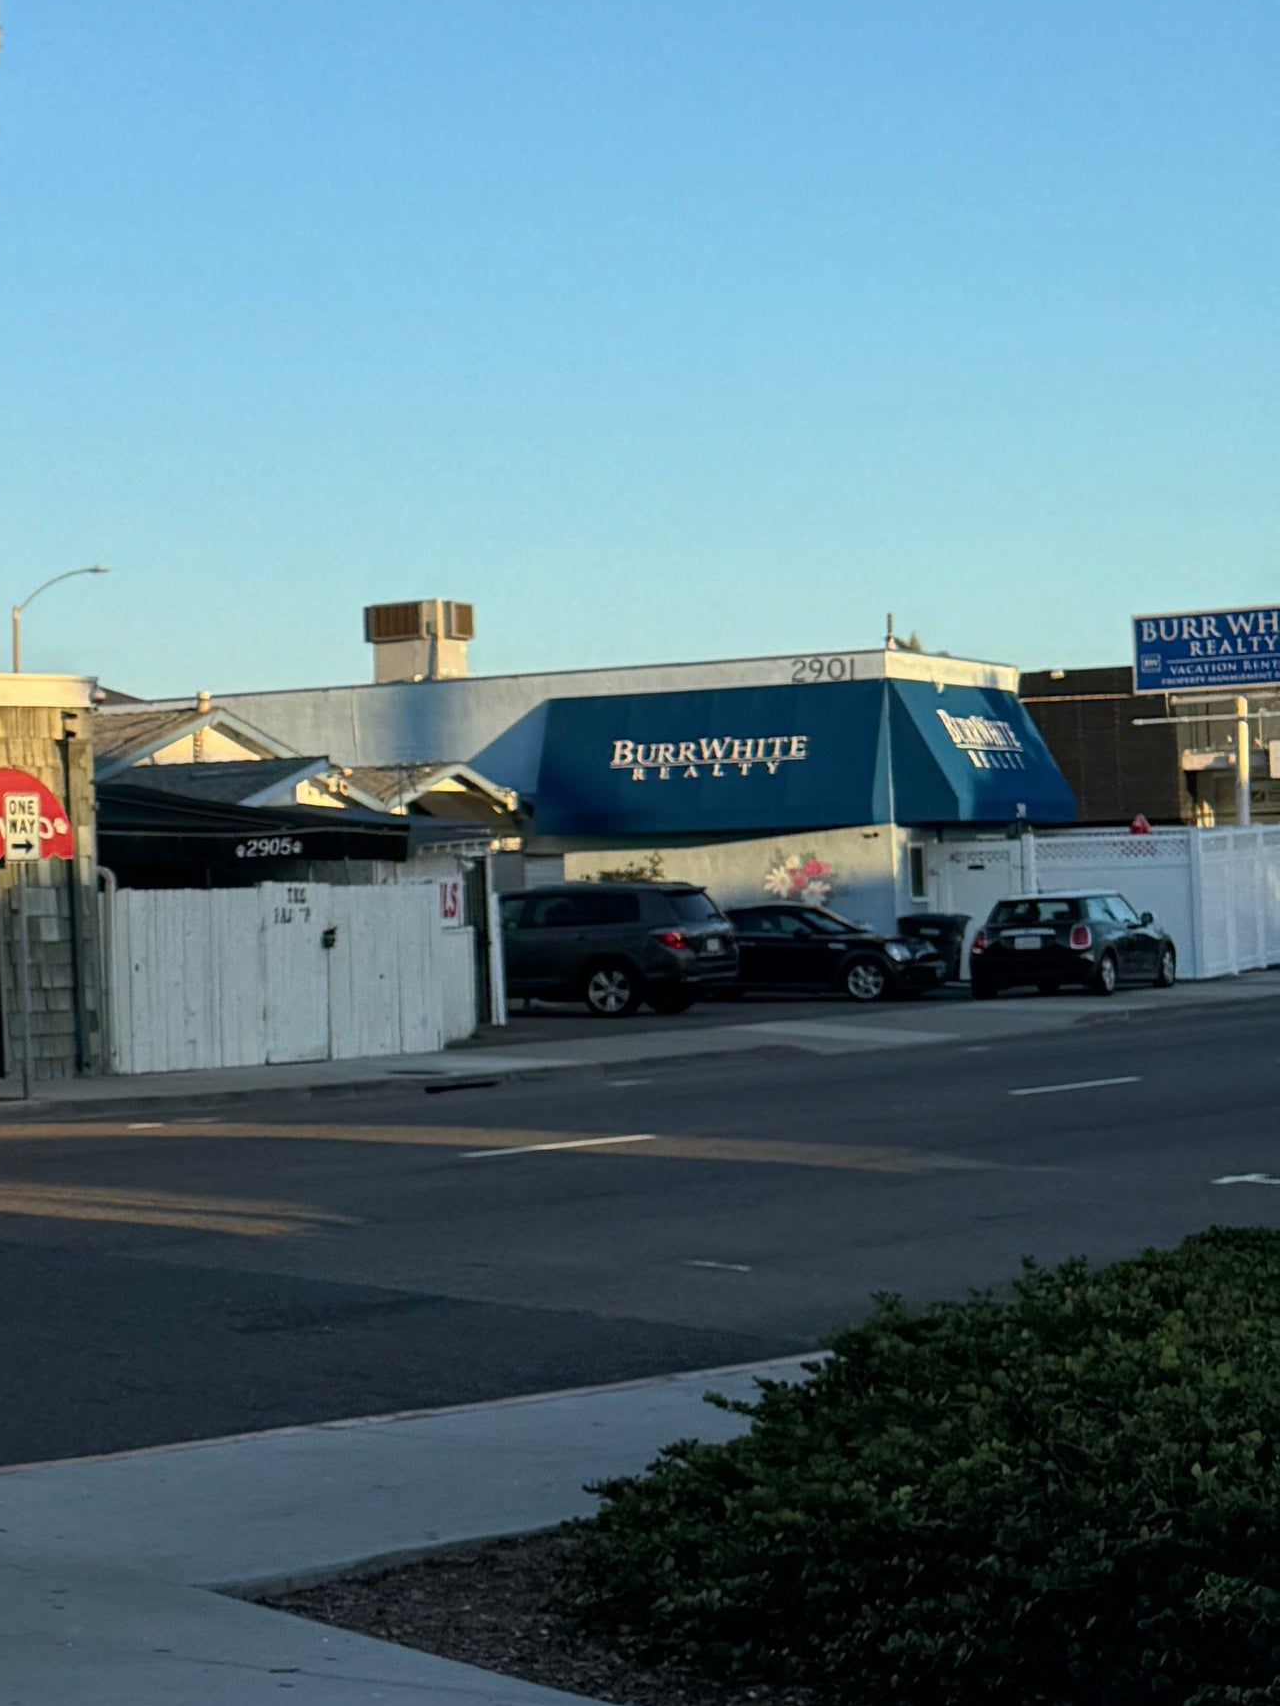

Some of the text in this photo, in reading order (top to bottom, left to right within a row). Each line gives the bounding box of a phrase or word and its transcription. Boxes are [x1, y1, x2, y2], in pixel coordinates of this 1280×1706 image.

[1141, 616, 1222, 643] BURR
[1189, 634, 1278, 657] REALTY
[791, 656, 855, 683] 2901
[1169, 661, 1237, 676] VACATION
[631, 759, 780, 781] REALTY
[9, 800, 35, 816] ONE
[8, 819, 36, 834] WAY
[245, 836, 293, 858] 2905
